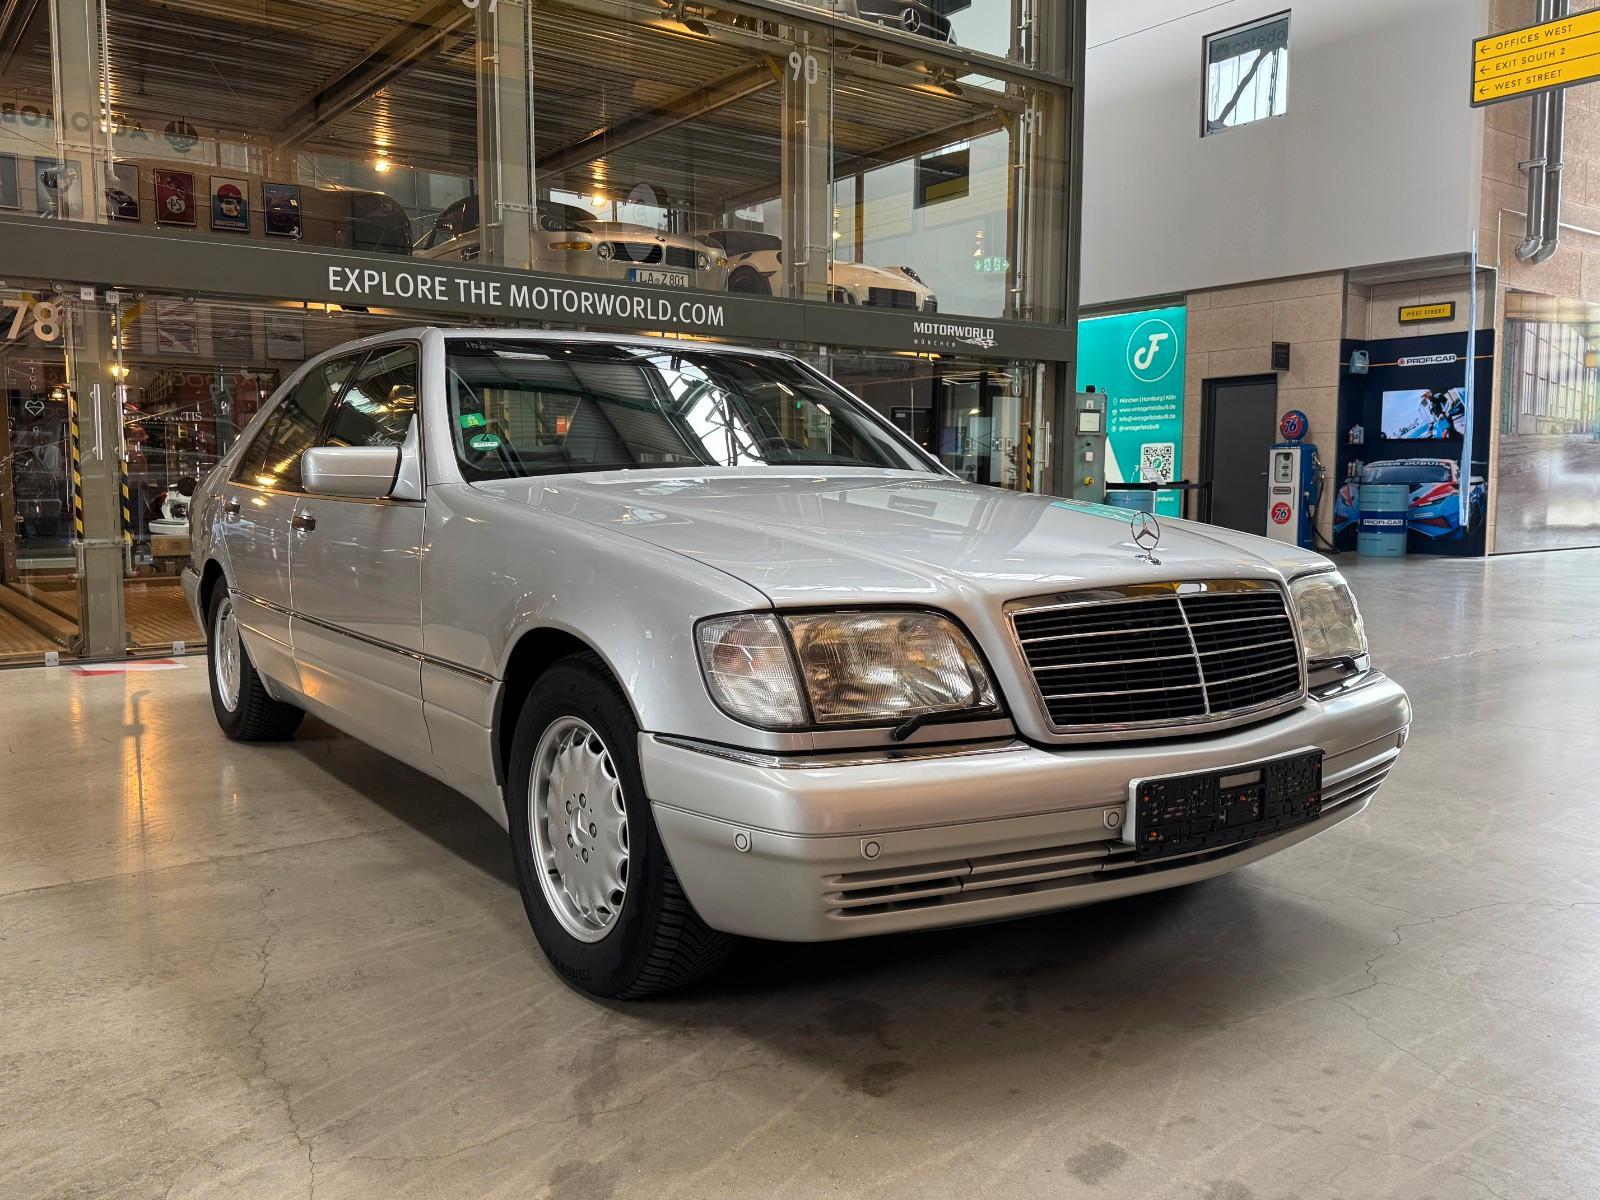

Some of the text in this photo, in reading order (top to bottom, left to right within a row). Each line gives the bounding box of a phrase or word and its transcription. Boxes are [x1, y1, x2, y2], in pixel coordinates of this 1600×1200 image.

[1496, 24, 1573, 50] OFFICES WEST
[789, 51, 818, 84] 90
[1496, 47, 1566, 71] EXIT SOUTH 2
[1495, 69, 1562, 90] WEST STREET
[1026, 108, 1043, 136] 91
[640, 271, 654, 285] LA
[328, 266, 724, 327] EXPLORE THE MOTORWORLD.COM
[3, 300, 60, 342] 78
[913, 321, 994, 340] MOTORWORLD
[1406, 355, 1456, 365] PROFI-CAR
[1284, 420, 1298, 433] 76
[1275, 508, 1288, 520] 76
